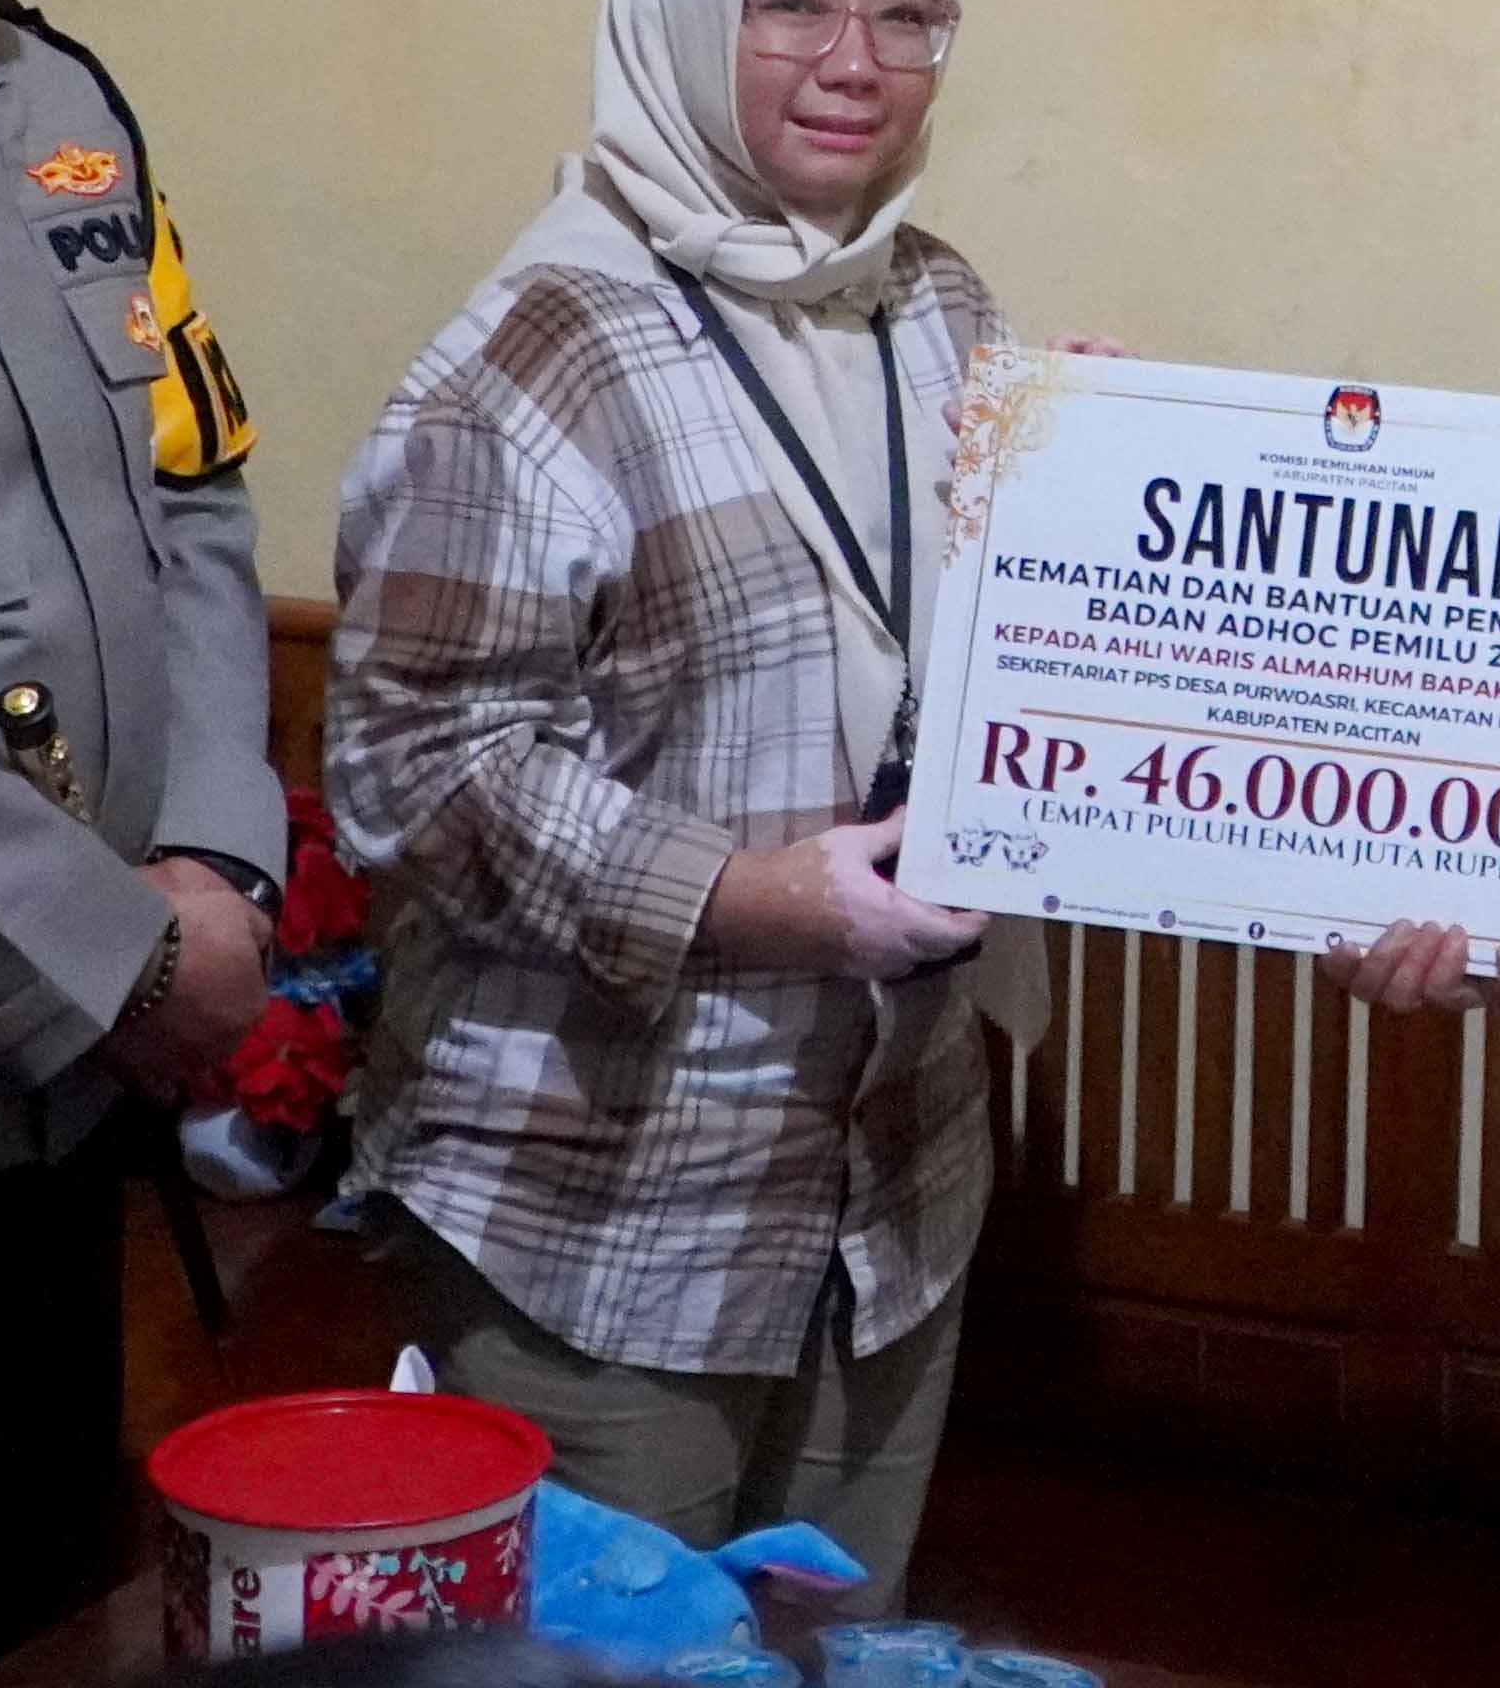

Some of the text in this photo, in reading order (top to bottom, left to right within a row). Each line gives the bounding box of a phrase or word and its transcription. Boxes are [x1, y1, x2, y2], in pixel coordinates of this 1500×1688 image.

[1259, 451, 1436, 480] KOMISI PEMILIHAN UMUM
[1273, 469, 1419, 493] KABUPATEN PACITAN
[994, 555, 1171, 596] KEMATIAN
[1181, 575, 1254, 607] DAN
[1265, 585, 1432, 627] BANTUAN
[994, 623, 1097, 652] KEPADA
[1104, 636, 1163, 659] AHLI
[1171, 643, 1255, 670] WARIS
[1262, 654, 1413, 689] ALMARHUM
[1086, 598, 1206, 633] BADAN
[1216, 613, 1339, 648] ADHOC
[1350, 628, 1477, 664] PEMILU
[997, 655, 1130, 684] SEKRETARIAT
[1133, 671, 1171, 689] PPS
[1176, 675, 1228, 696] DESA
[1364, 698, 1494, 729] KECAMATAN
[976, 720, 1097, 798] RP.
[1207, 706, 1421, 747] KABUPATEN PACITAN
[1040, 800, 1140, 833] EMPAT
[1145, 813, 1249, 847] PULUH
[1257, 831, 1346, 860] ENAM
[1351, 841, 1425, 870] JUTA
